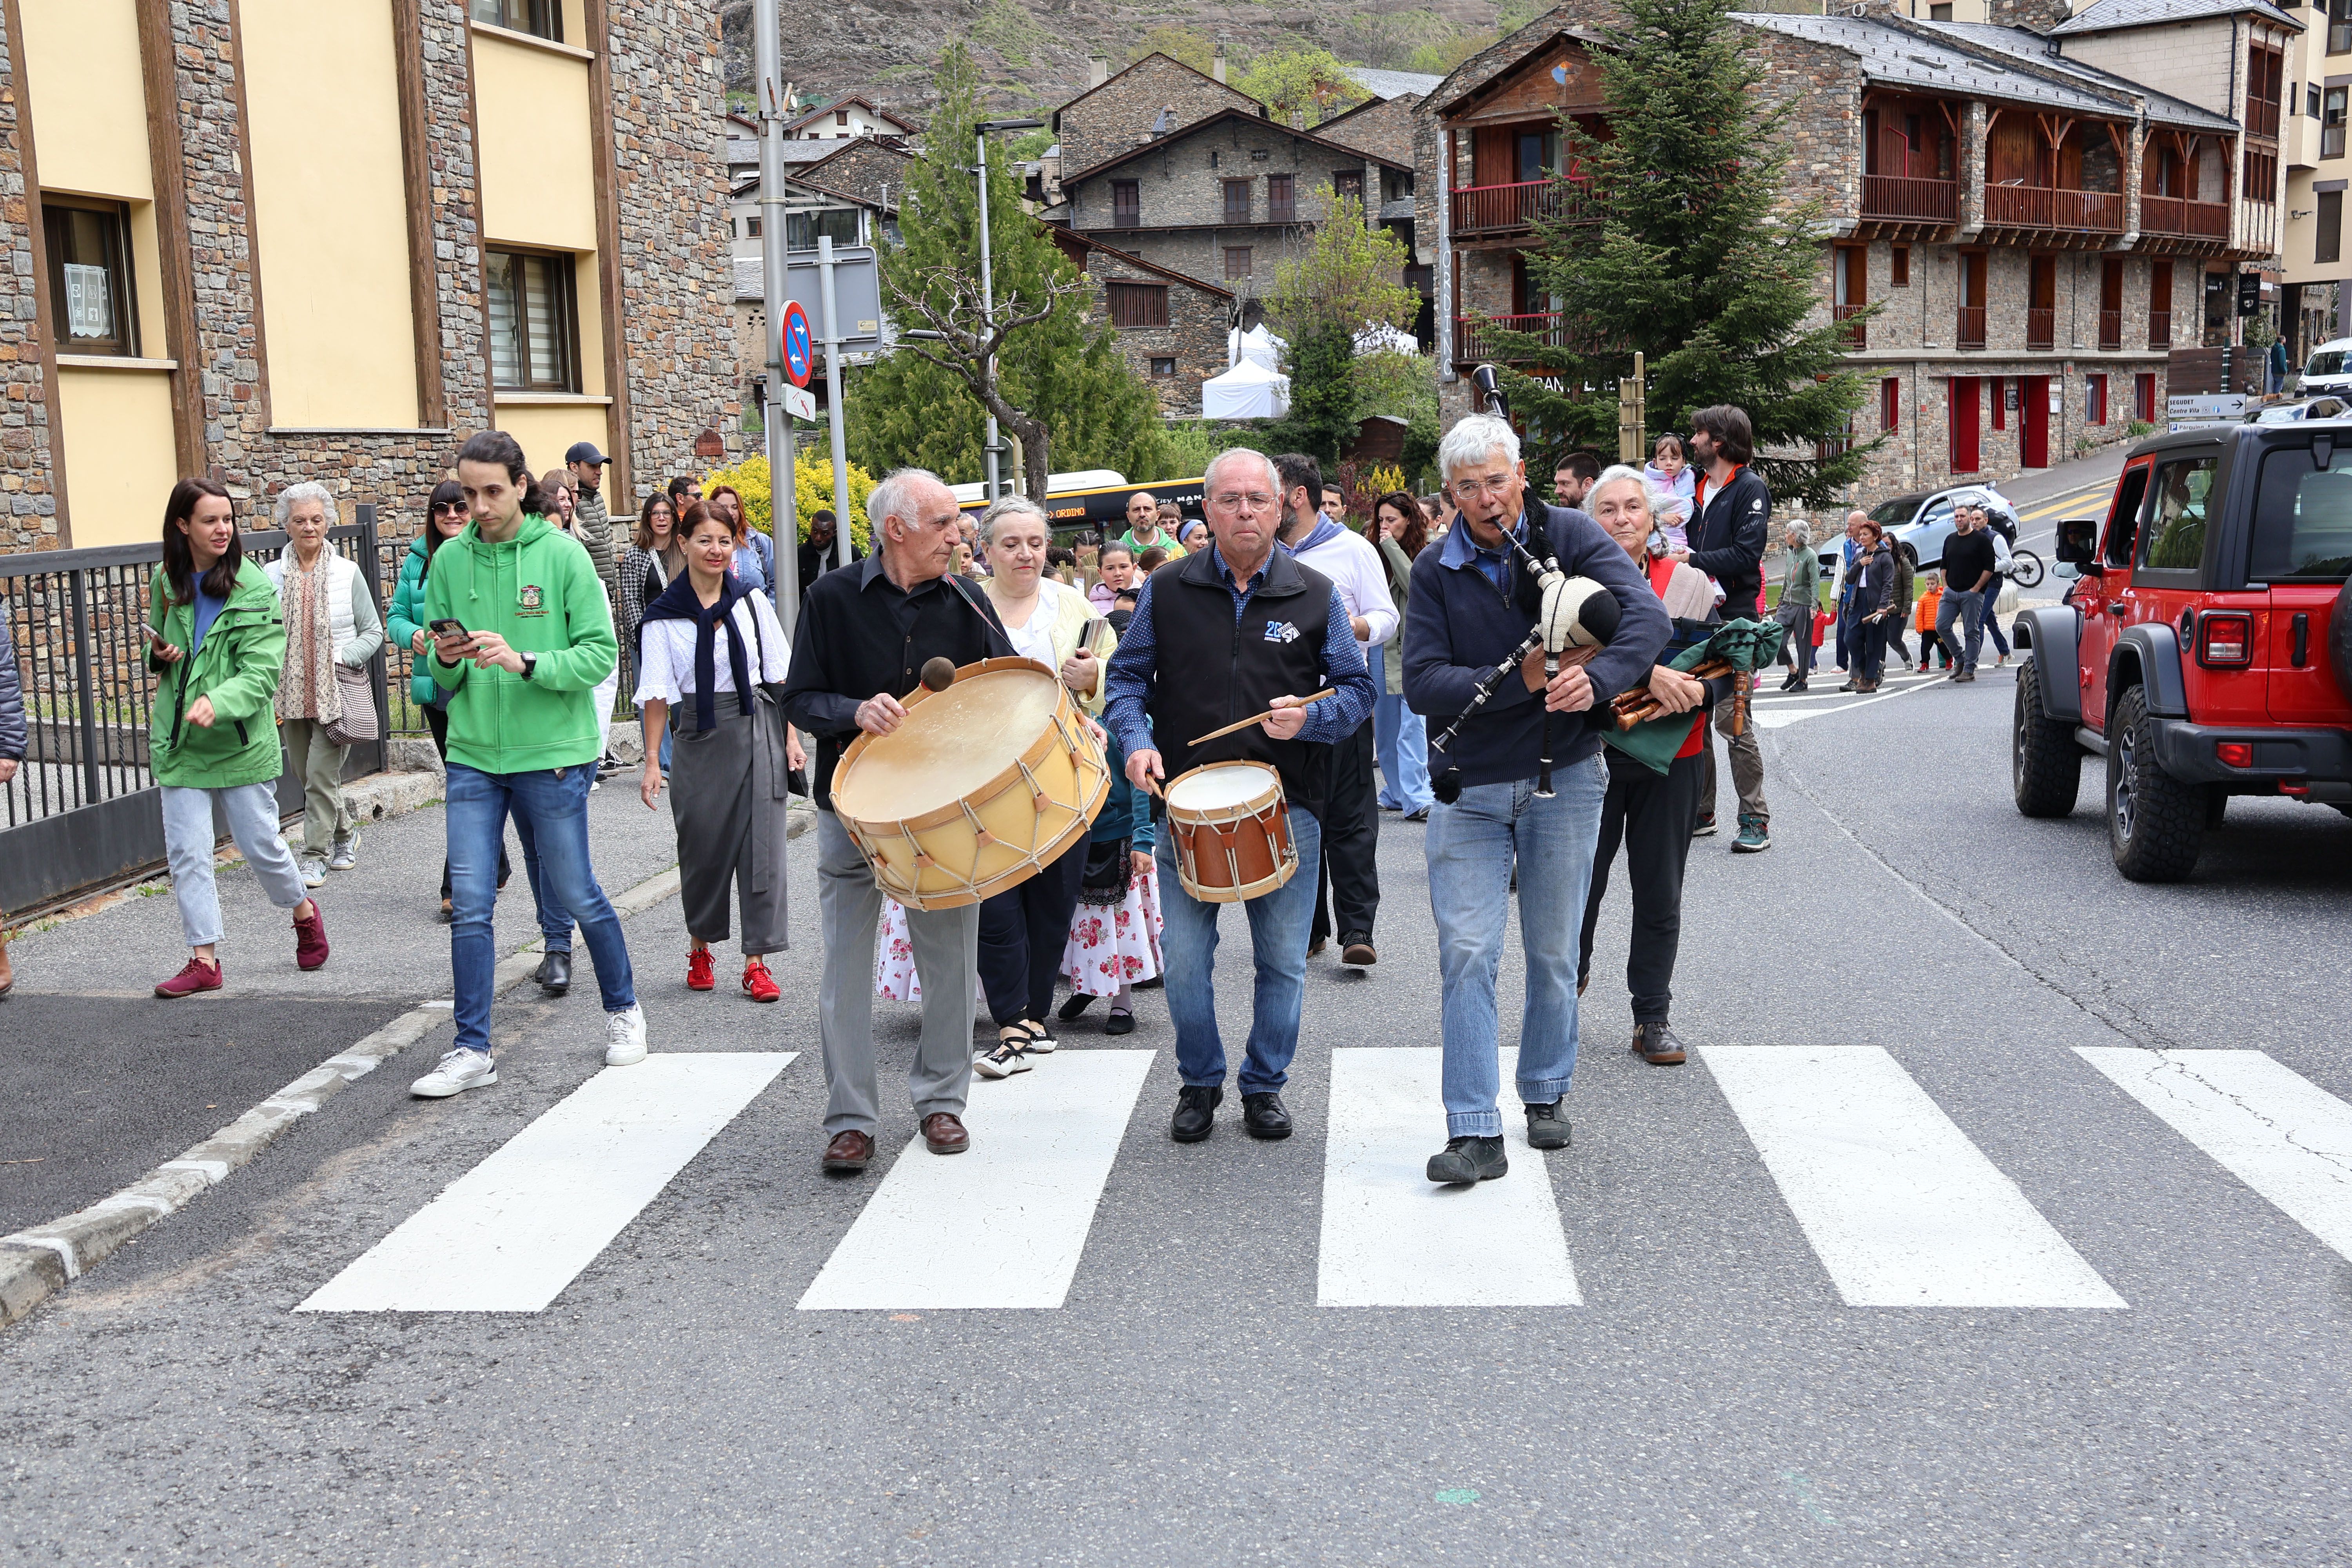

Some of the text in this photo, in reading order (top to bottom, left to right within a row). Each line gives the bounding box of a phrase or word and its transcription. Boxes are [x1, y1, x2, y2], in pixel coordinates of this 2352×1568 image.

[1442, 250, 1452, 376] ORDINO
[1176, 494, 1202, 503] MAN
[1056, 507, 1085, 518] ORDINO
[1265, 621, 1283, 638] 20
